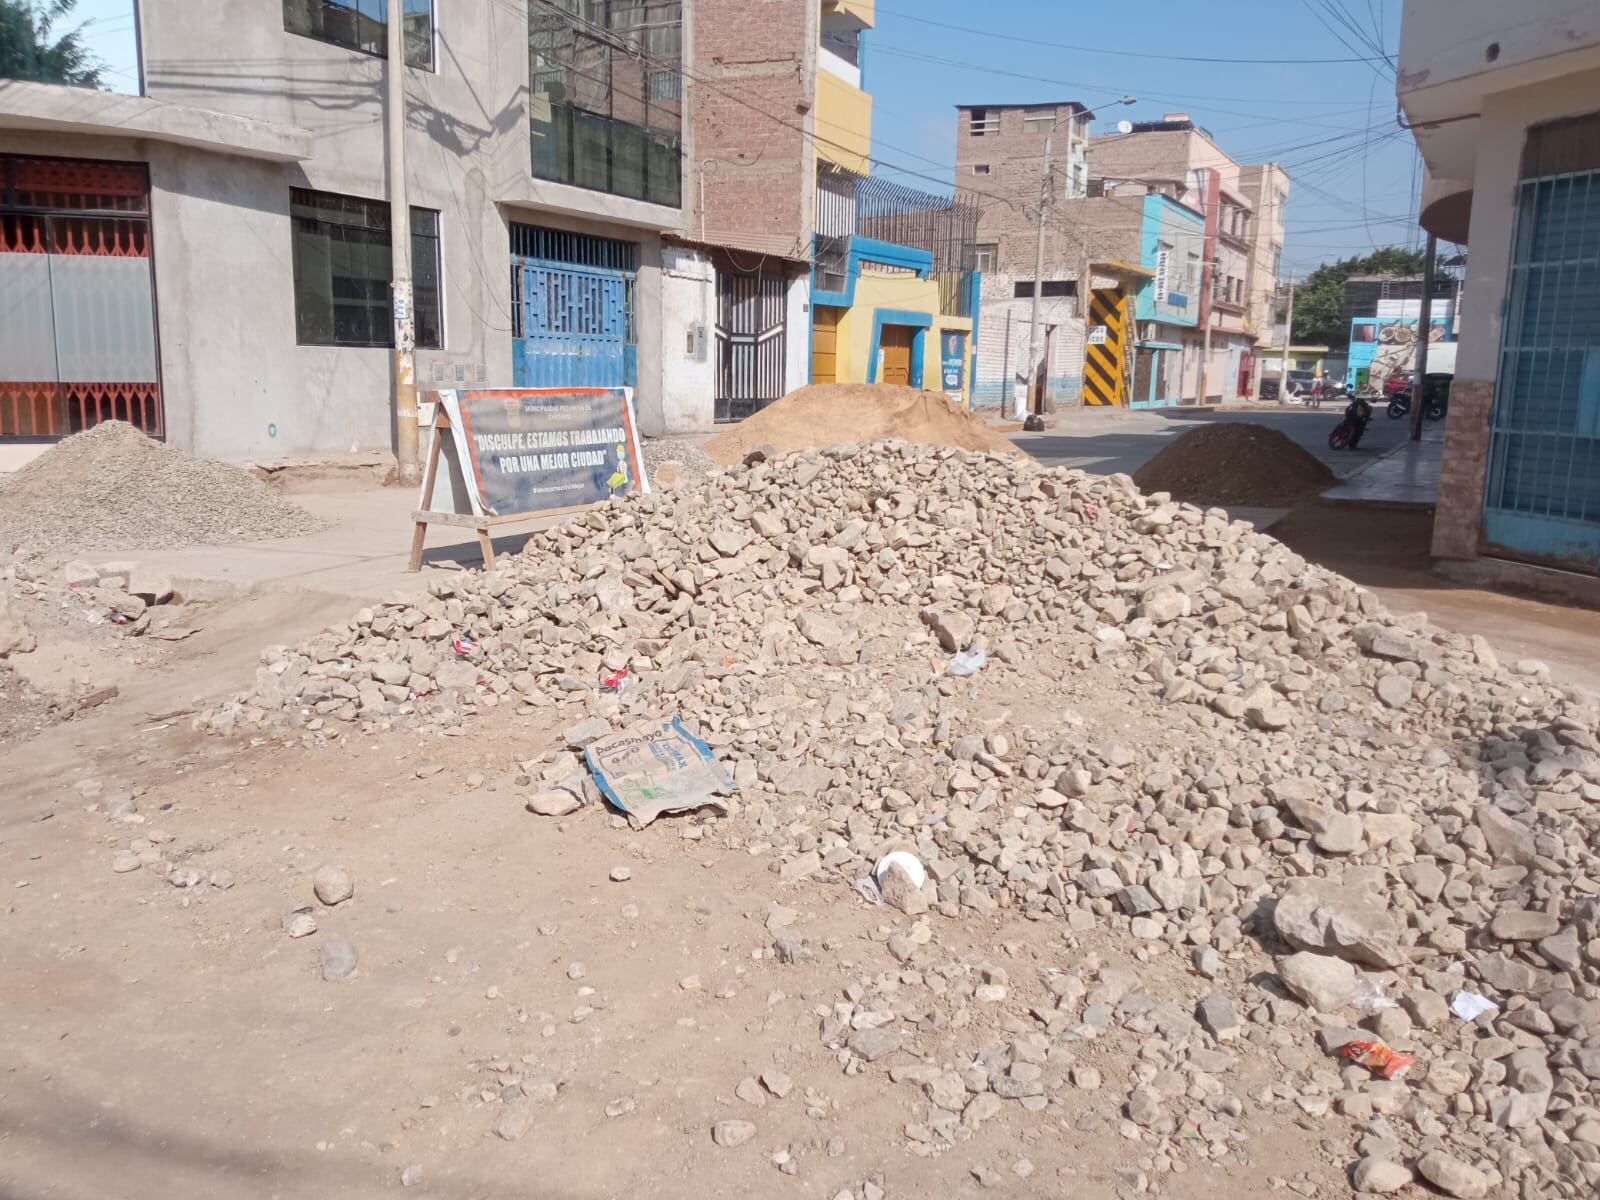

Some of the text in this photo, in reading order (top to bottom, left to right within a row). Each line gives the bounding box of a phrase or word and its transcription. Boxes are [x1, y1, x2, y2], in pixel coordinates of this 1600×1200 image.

[527, 431, 568, 448] ESTAMOS
[569, 428, 626, 446] TRABAJANDO
[500, 456, 520, 473] POR
[521, 455, 541, 472] UNA
[541, 453, 570, 471] MEJOR
